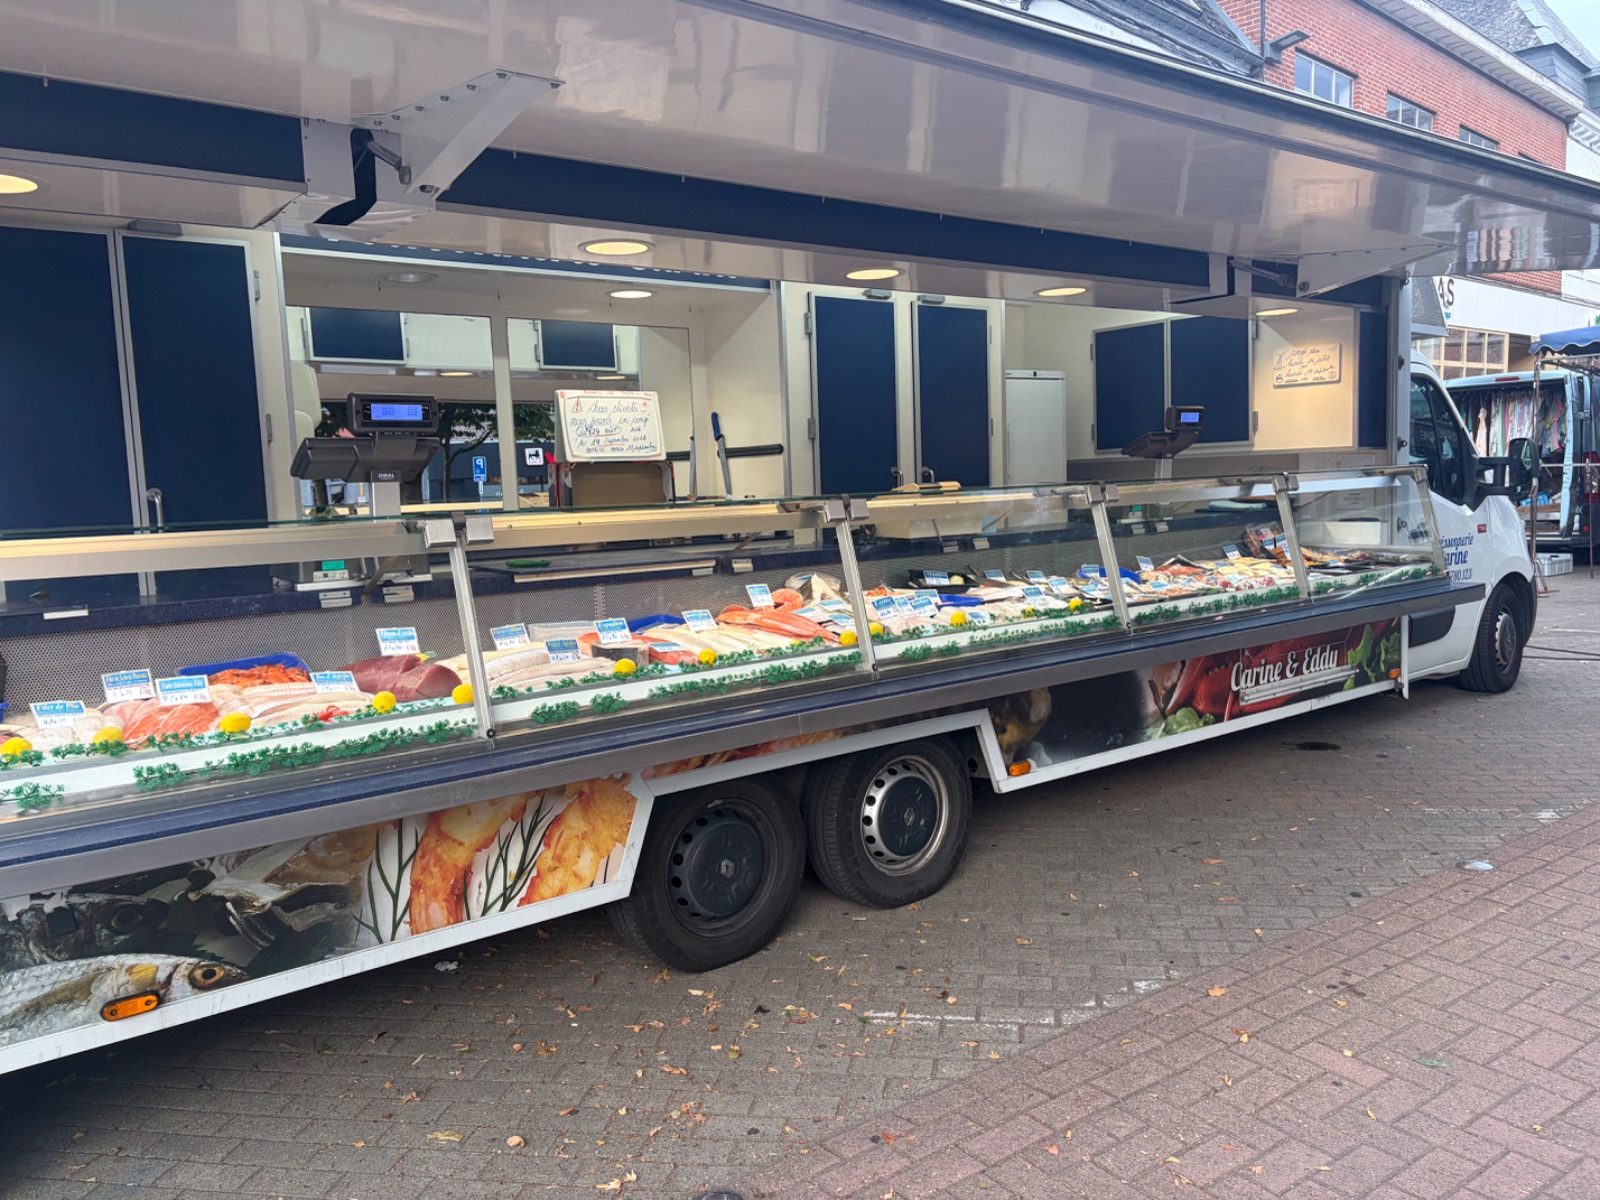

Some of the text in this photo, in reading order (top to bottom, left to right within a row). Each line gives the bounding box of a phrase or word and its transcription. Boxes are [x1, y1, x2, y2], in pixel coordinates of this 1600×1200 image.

[1443, 547, 1469, 566] arine
[1231, 644, 1339, 692] Carine & Eddy
